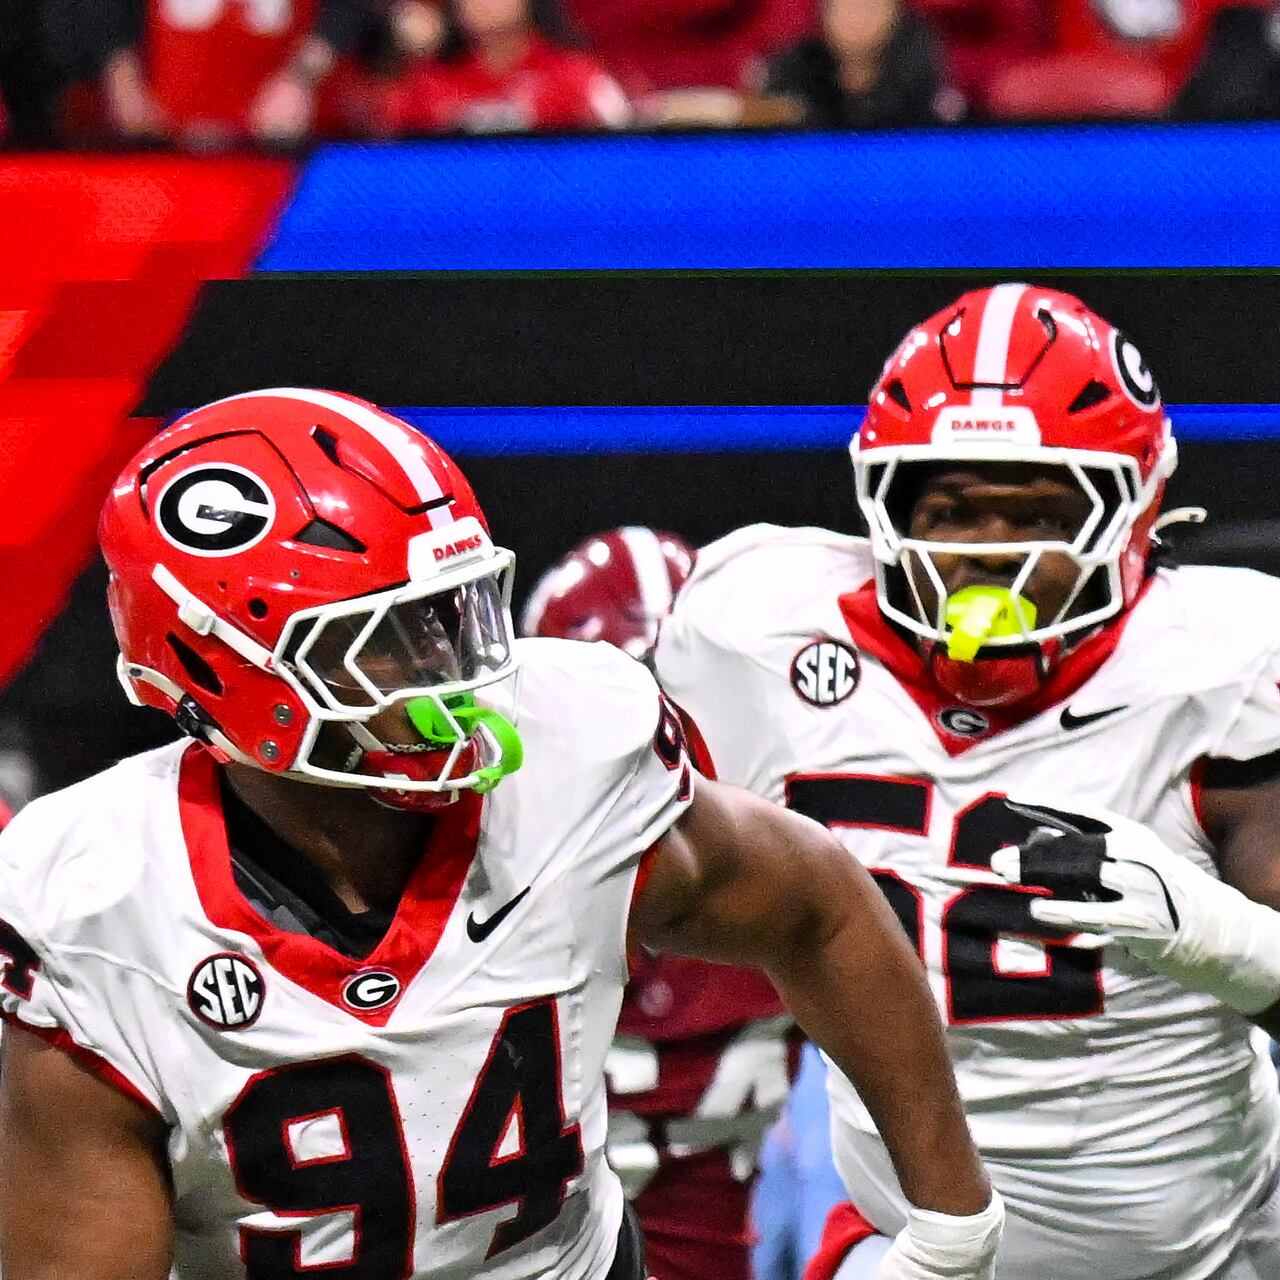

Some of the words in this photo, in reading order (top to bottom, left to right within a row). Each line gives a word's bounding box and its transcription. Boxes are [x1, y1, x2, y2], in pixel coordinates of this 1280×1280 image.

[951, 419, 1016, 431] DAWGS
[156, 463, 275, 557] G
[795, 642, 858, 703] SEC
[938, 706, 990, 736] G
[192, 957, 261, 1026] SEC
[344, 970, 400, 1010] G
